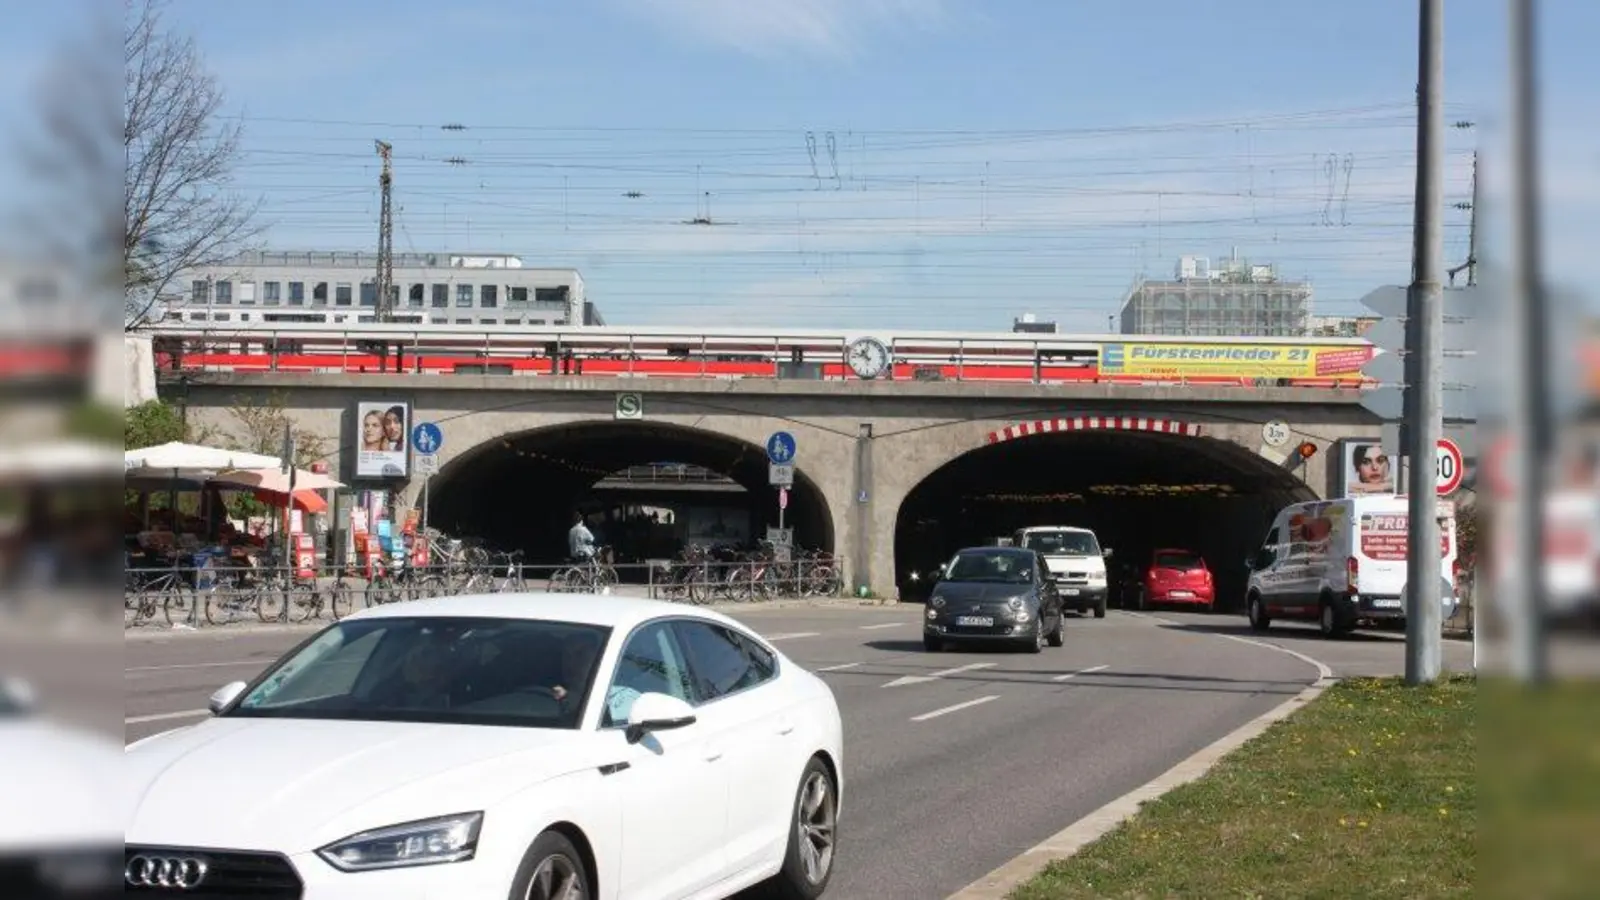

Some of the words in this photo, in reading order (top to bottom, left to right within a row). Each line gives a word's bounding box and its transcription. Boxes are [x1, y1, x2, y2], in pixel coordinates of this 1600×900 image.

[1131, 344, 1281, 359] Fürstenrieder
[1287, 348, 1311, 360] 21
[622, 395, 638, 416] S
[1371, 515, 1408, 532] PRO
